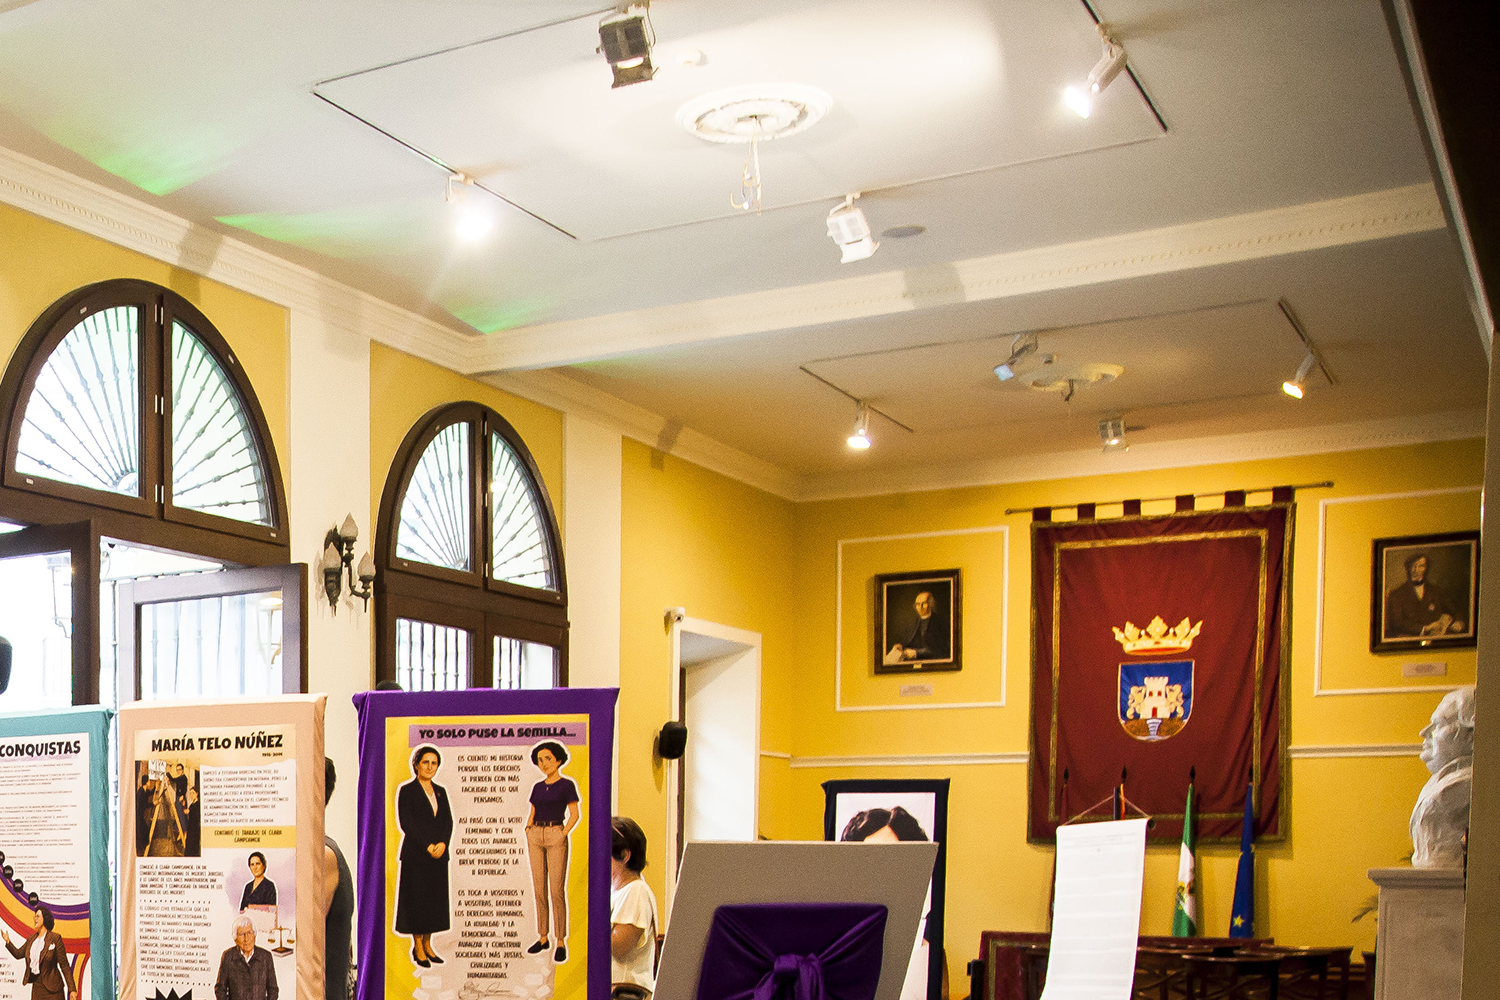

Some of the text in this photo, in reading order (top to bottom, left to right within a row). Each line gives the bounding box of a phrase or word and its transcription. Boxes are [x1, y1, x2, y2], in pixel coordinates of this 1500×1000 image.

[198, 737, 232, 750] TELO
[235, 731, 283, 749] NÚÑEZ
[419, 729, 435, 739] YO
[437, 728, 466, 739] SOLO
